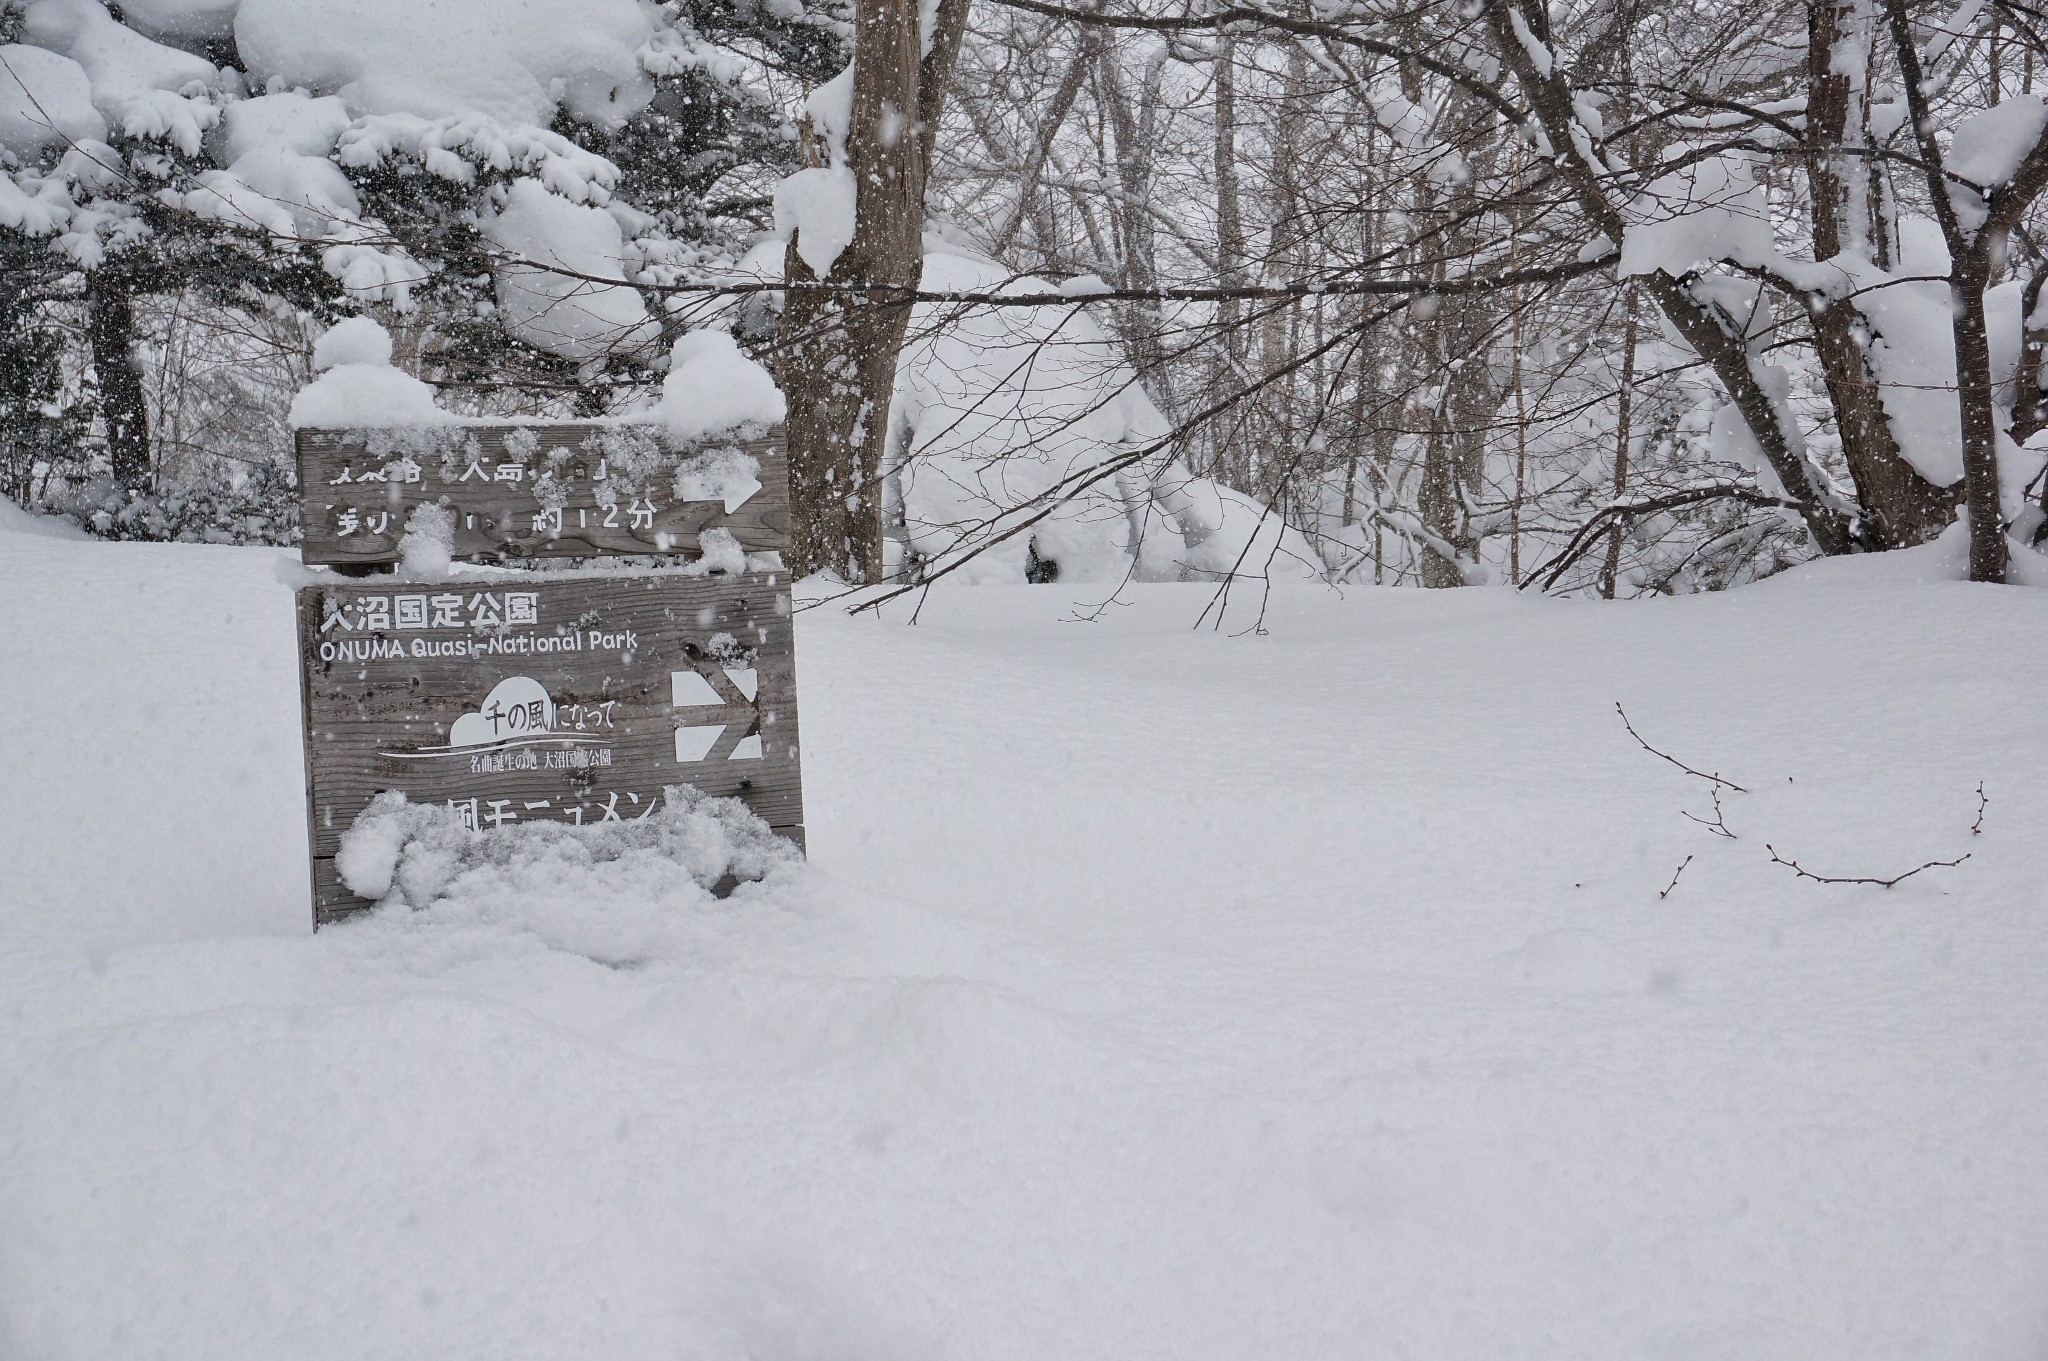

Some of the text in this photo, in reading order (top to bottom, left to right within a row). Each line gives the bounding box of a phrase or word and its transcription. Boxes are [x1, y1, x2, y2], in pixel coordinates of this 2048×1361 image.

[319, 591, 539, 633] 大沼国定公園
[319, 629, 639, 662] ONUMA Quasi-National Park
[484, 698, 616, 736] 千の風になって
[469, 748, 612, 774] 名曲誕生の地 大沼国公園
